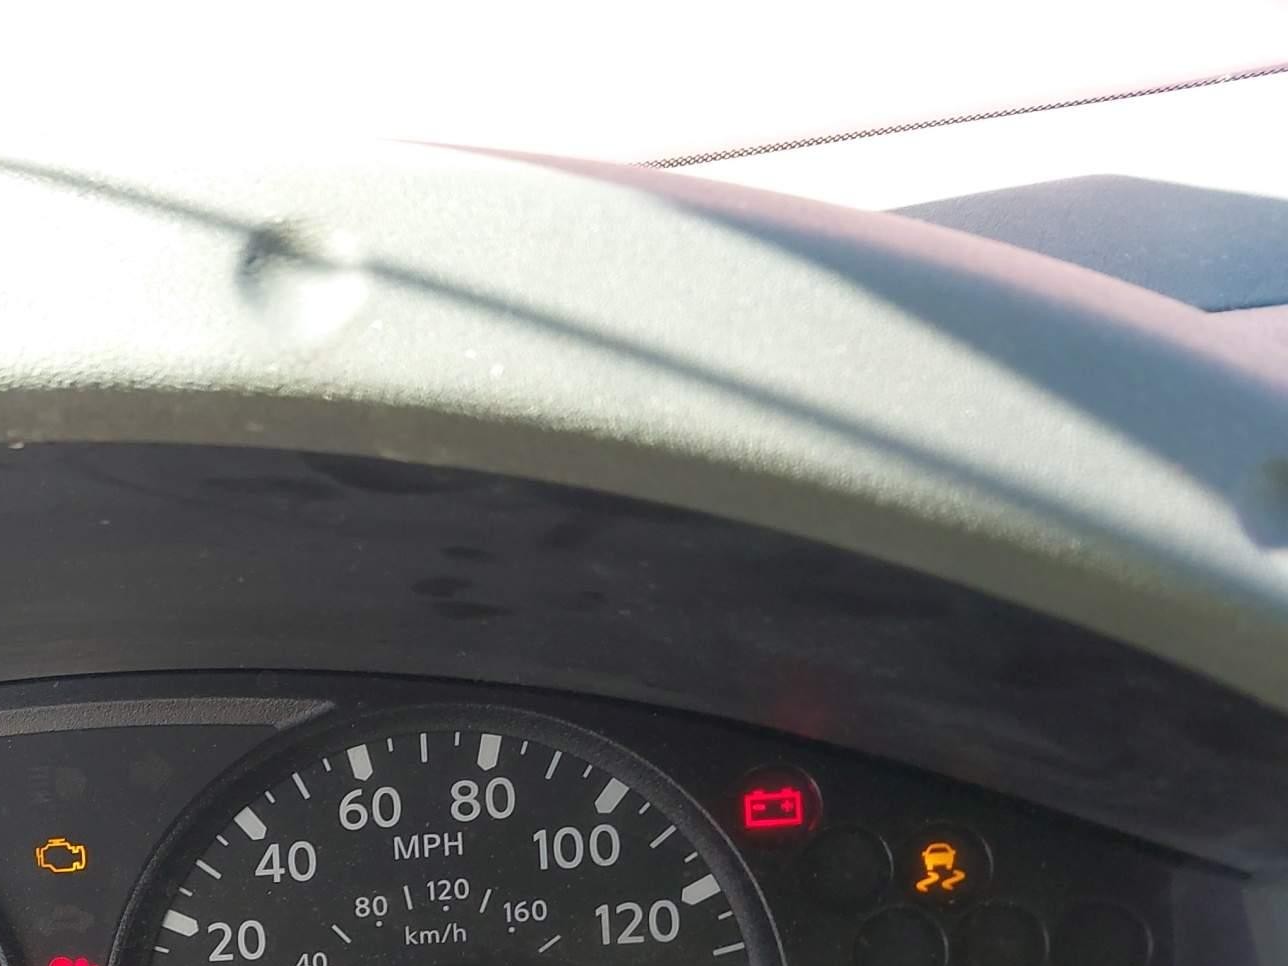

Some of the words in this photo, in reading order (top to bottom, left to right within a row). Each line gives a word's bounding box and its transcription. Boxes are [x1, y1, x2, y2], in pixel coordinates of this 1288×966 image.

[339, 786, 402, 831] 60
[450, 777, 516, 822] 80
[254, 840, 317, 883] 40
[393, 831, 463, 860] MPH
[533, 824, 620, 870] 100
[355, 895, 388, 918] 80
[426, 878, 470, 901] 120
[503, 899, 547, 923] 160
[207, 919, 266, 962] 20
[405, 922, 467, 945] km/h
[595, 900, 681, 946] 120
